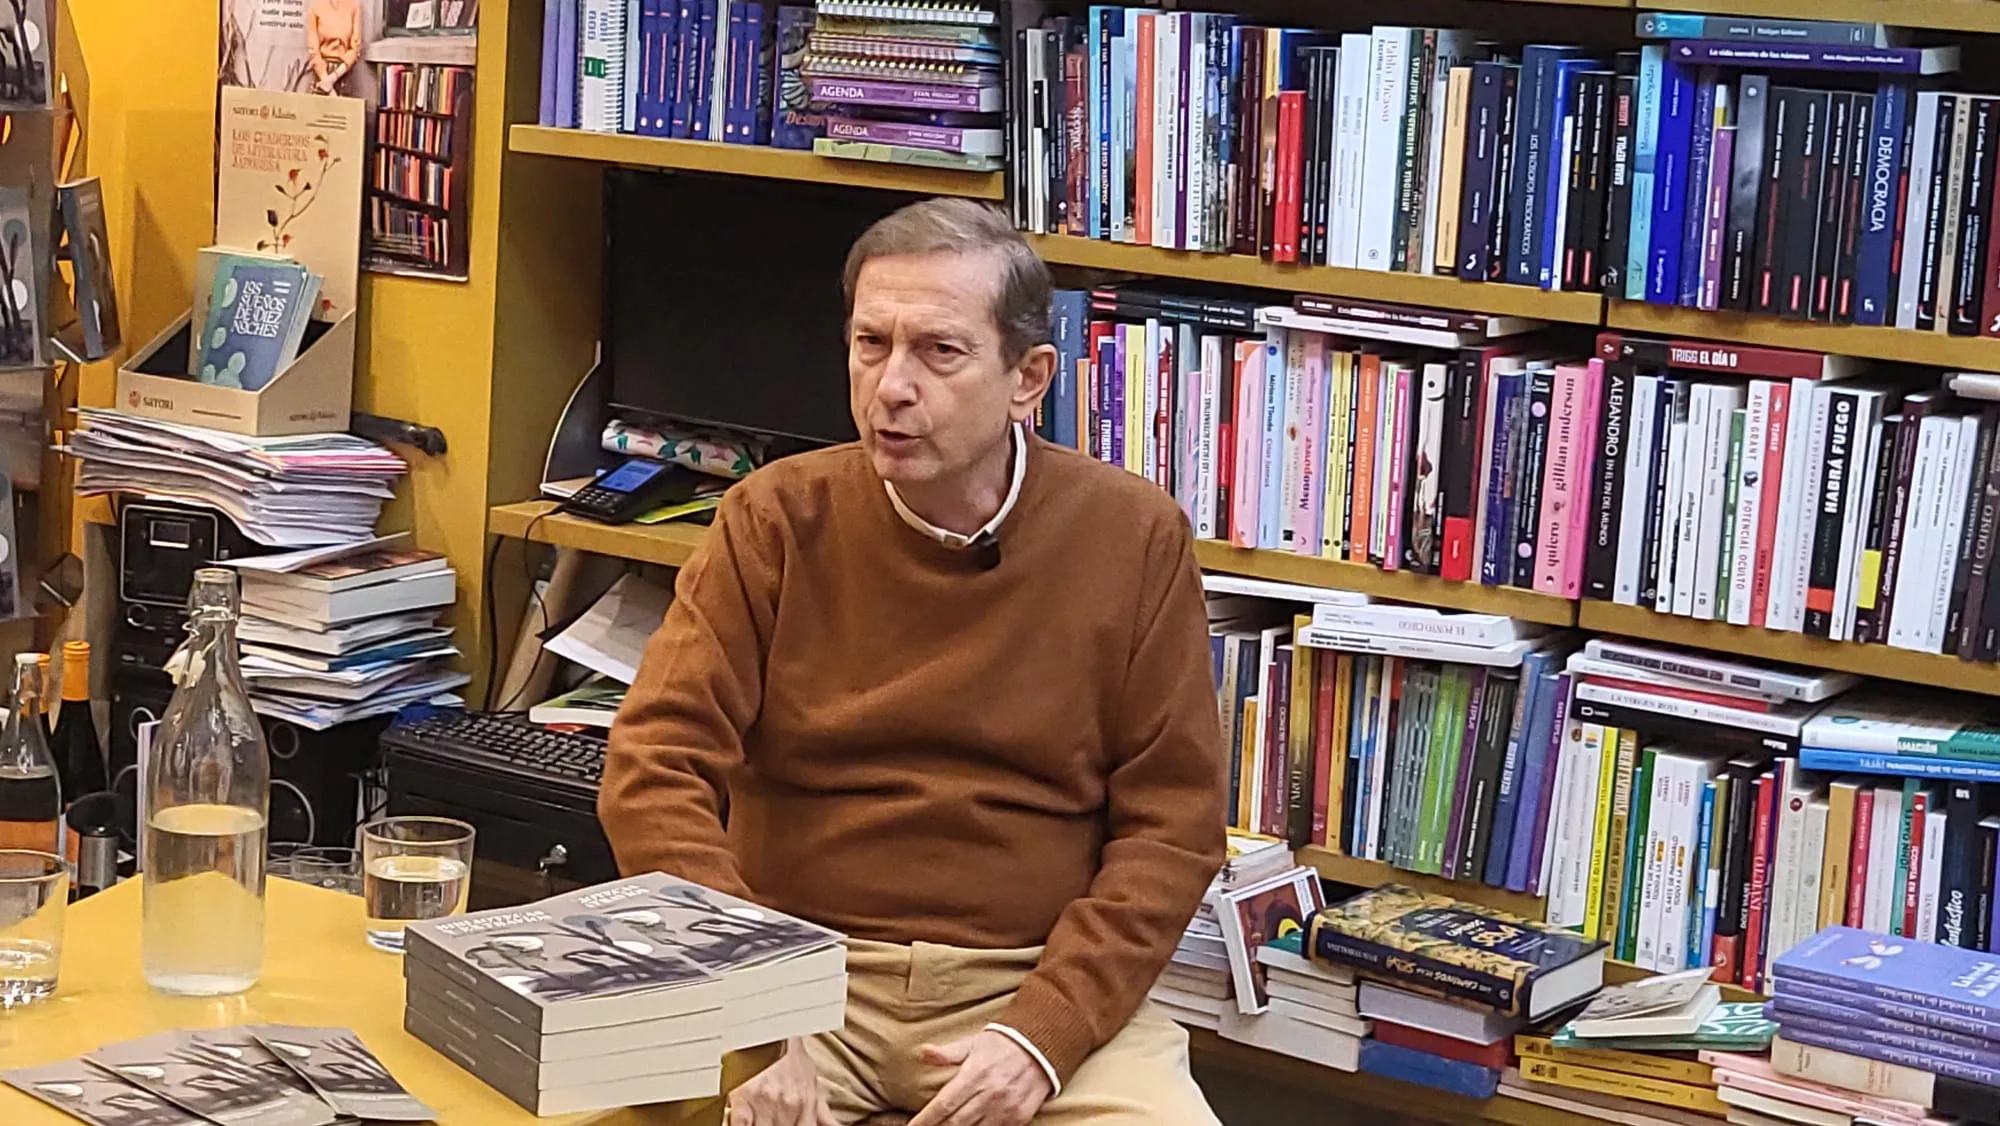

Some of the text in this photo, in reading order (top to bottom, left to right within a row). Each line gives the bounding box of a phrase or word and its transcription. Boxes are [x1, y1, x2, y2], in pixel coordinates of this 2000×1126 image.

[1376, 39, 1384, 70] Escritos
[820, 87, 864, 98] AGENDA
[1381, 39, 1397, 122] Pablo Picasso
[232, 128, 250, 141] LOS
[833, 124, 868, 137] AGENDA
[1529, 134, 1538, 150] LOS
[1526, 152, 1538, 193] FILÓSOFOS
[1868, 135, 1894, 233] DEMOCRACIA
[230, 320, 280, 337] NOCHES
[1698, 350, 1710, 364] EL
[1711, 348, 1729, 366] DÍA
[1100, 419, 1112, 461] FEMINISMO
[1550, 376, 1576, 491] gillian anderson
[1747, 394, 1763, 461] ADAM GRANT
[1358, 427, 1368, 472] FEMINISTA
[1598, 375, 1624, 545] ALEJANDRO EN EL FIN DEL MUNDO
[1823, 400, 1851, 515] HABRÁ FUEGO
[1298, 436, 1314, 510] Menopower
[1543, 521, 1563, 567] quiero
[1735, 499, 1753, 590] POTENCIAL OCULTO
[1974, 503, 1994, 559] COLISEO
[1936, 567, 1949, 601] VIRGEN
[1934, 602, 1943, 616] LA
[1423, 620, 1453, 636] PUNTO
[1452, 623, 1465, 637] EL
[1609, 693, 1621, 702] LA
[1622, 695, 1657, 709] VIRGEN
[1898, 842, 1911, 870] JOHN
[1907, 881, 1916, 892] EN
[1739, 907, 1749, 928] DOCE
[1940, 889, 1963, 948] fantástico
[1383, 952, 1417, 976] SEDA
[1432, 967, 1479, 994] CAMINOS
